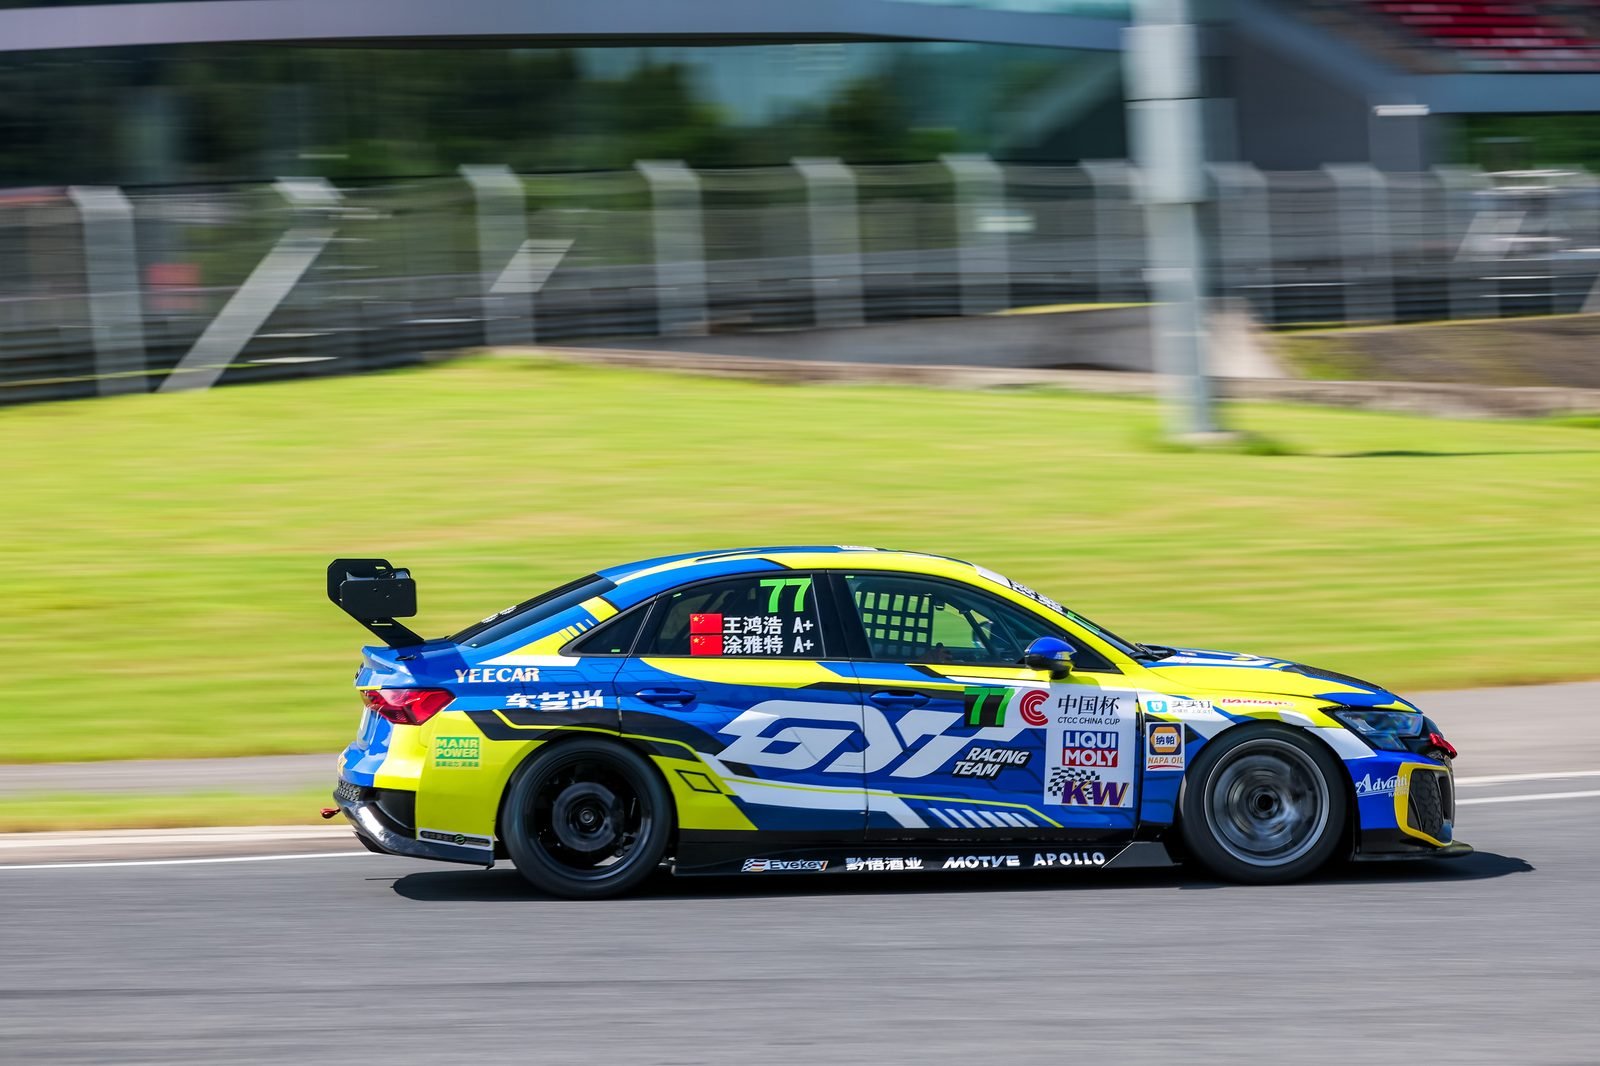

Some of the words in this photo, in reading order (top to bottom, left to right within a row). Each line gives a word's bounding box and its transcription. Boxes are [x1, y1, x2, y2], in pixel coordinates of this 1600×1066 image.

[760, 578, 811, 613] 77
[723, 616, 783, 634] 王鸿浩
[792, 617, 814, 634] A+
[723, 635, 784, 654] 涂雅特
[793, 636, 814, 653] A+
[454, 667, 541, 684] YEECAR
[964, 687, 1015, 726] 77
[1058, 694, 1120, 715] 中国杯
[1058, 716, 1078, 724] CTCC
[1079, 717, 1102, 725] CHINA
[1065, 732, 1117, 748] LIQUI
[1155, 735, 1175, 745] 纳帕
[436, 749, 479, 758] POWER
[965, 747, 1030, 765] RACING
[1064, 750, 1117, 766] MOLY
[1147, 756, 1168, 764] NAPA
[1171, 756, 1183, 764] OIL
[952, 761, 1000, 777] TEAM
[1061, 780, 1129, 806] KW
[770, 860, 827, 871] Evekey
[1033, 852, 1105, 866] APOLLO
